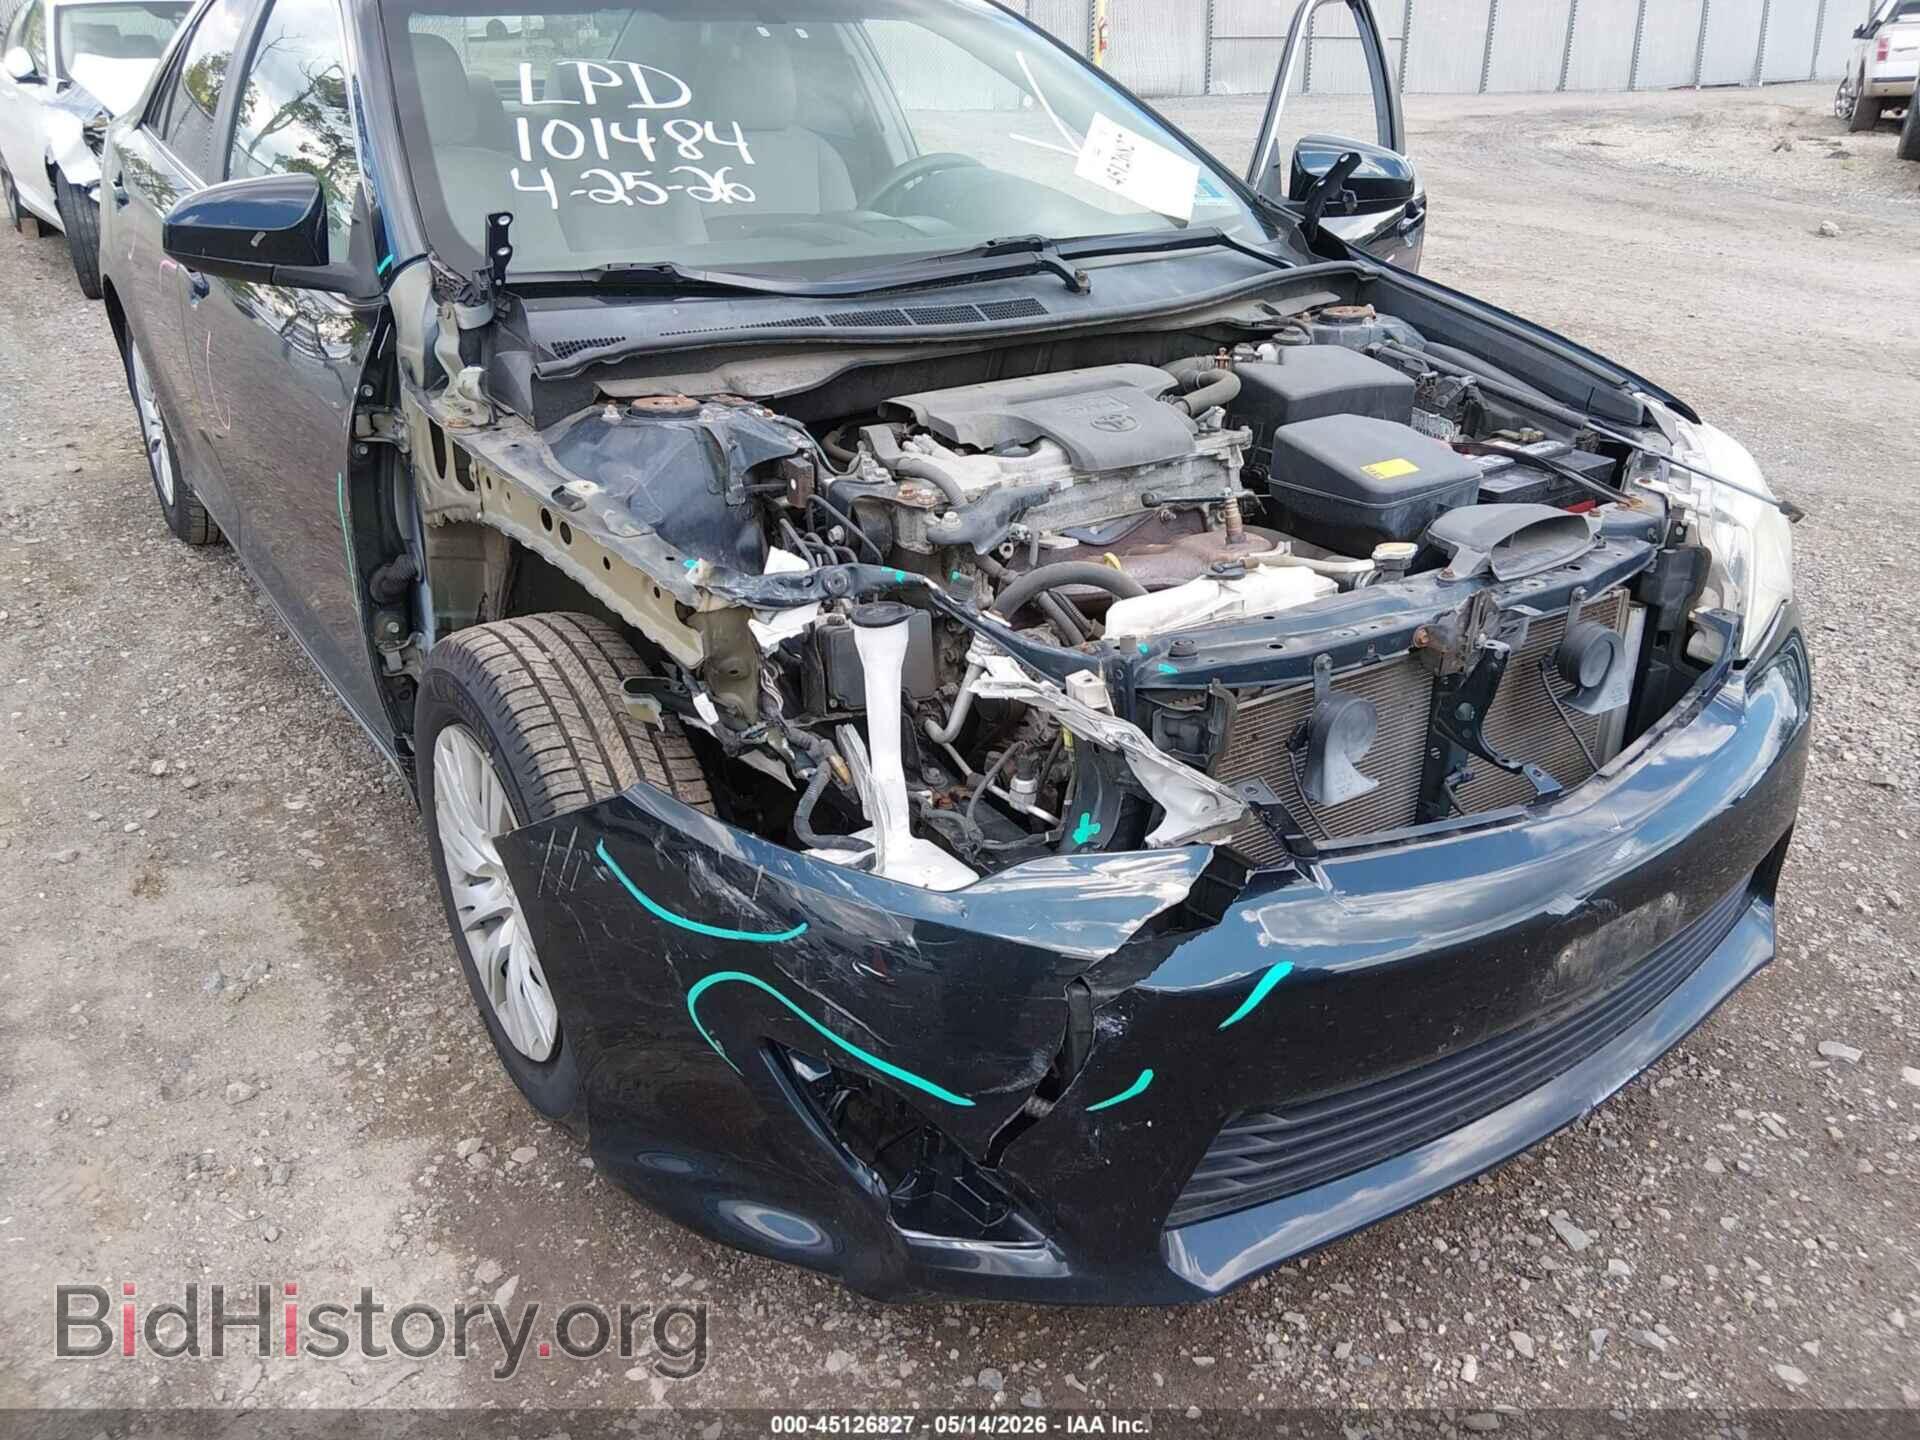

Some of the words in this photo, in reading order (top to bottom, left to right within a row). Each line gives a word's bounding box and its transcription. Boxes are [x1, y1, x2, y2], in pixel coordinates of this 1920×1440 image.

[518, 60, 693, 109] LPD
[516, 117, 756, 165] 101484
[509, 166, 757, 210] 4-25-26
